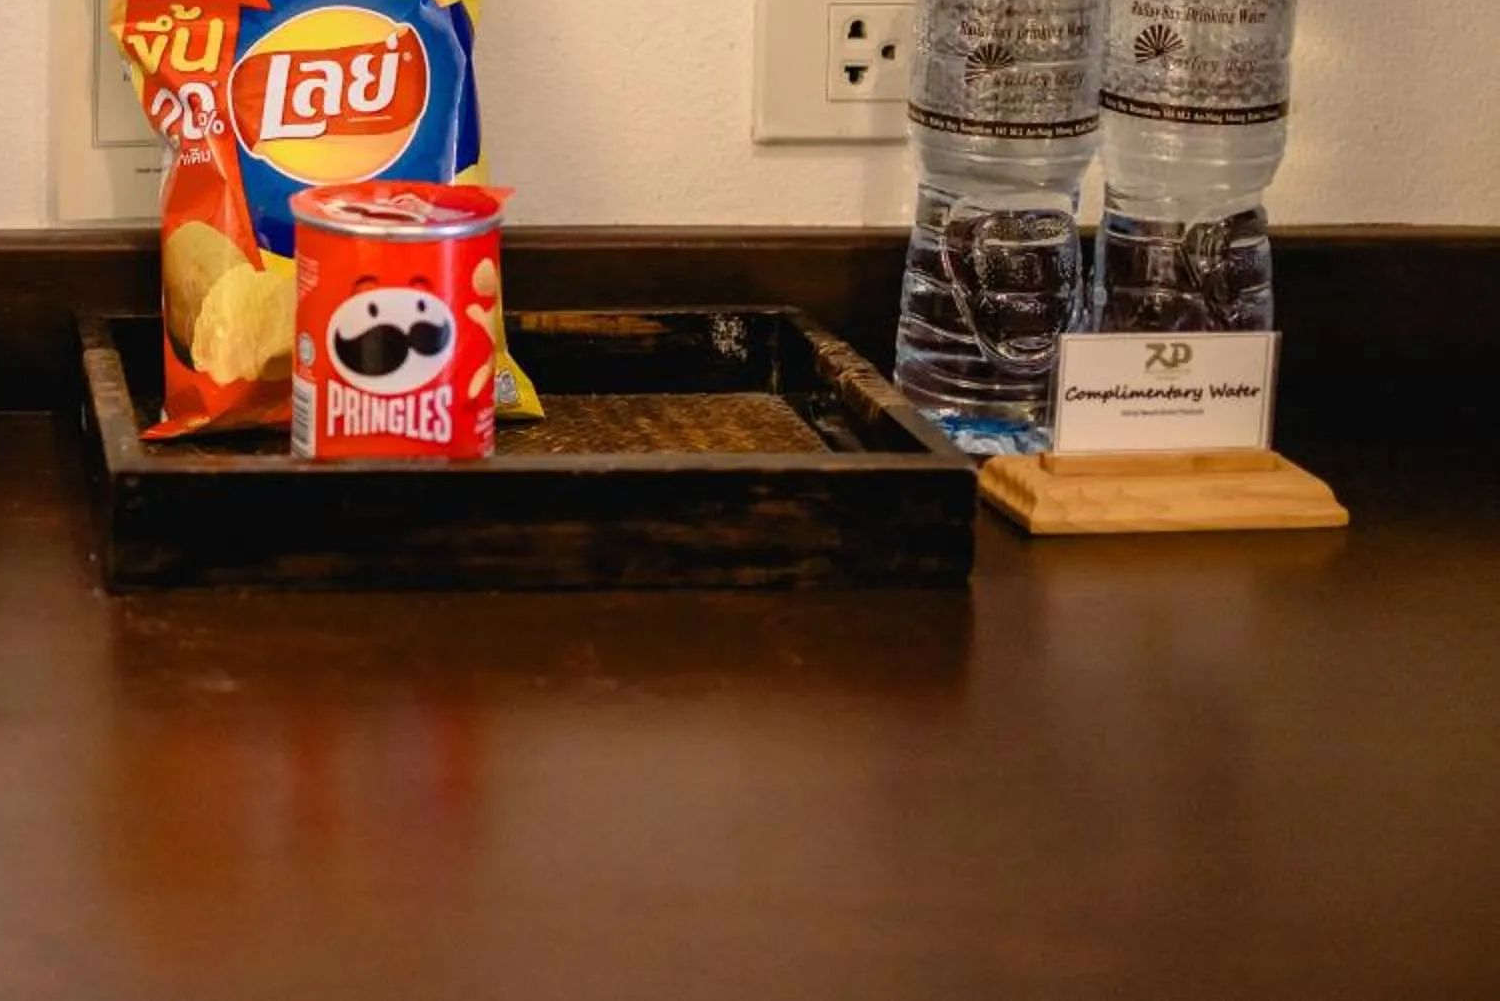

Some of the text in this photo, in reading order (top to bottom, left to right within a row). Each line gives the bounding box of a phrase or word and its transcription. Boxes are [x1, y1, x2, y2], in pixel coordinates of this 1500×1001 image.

[127, 3, 224, 74] ขึ้น
[326, 378, 453, 444] PRINGLES
[1065, 382, 1261, 404] Complimentary Water
